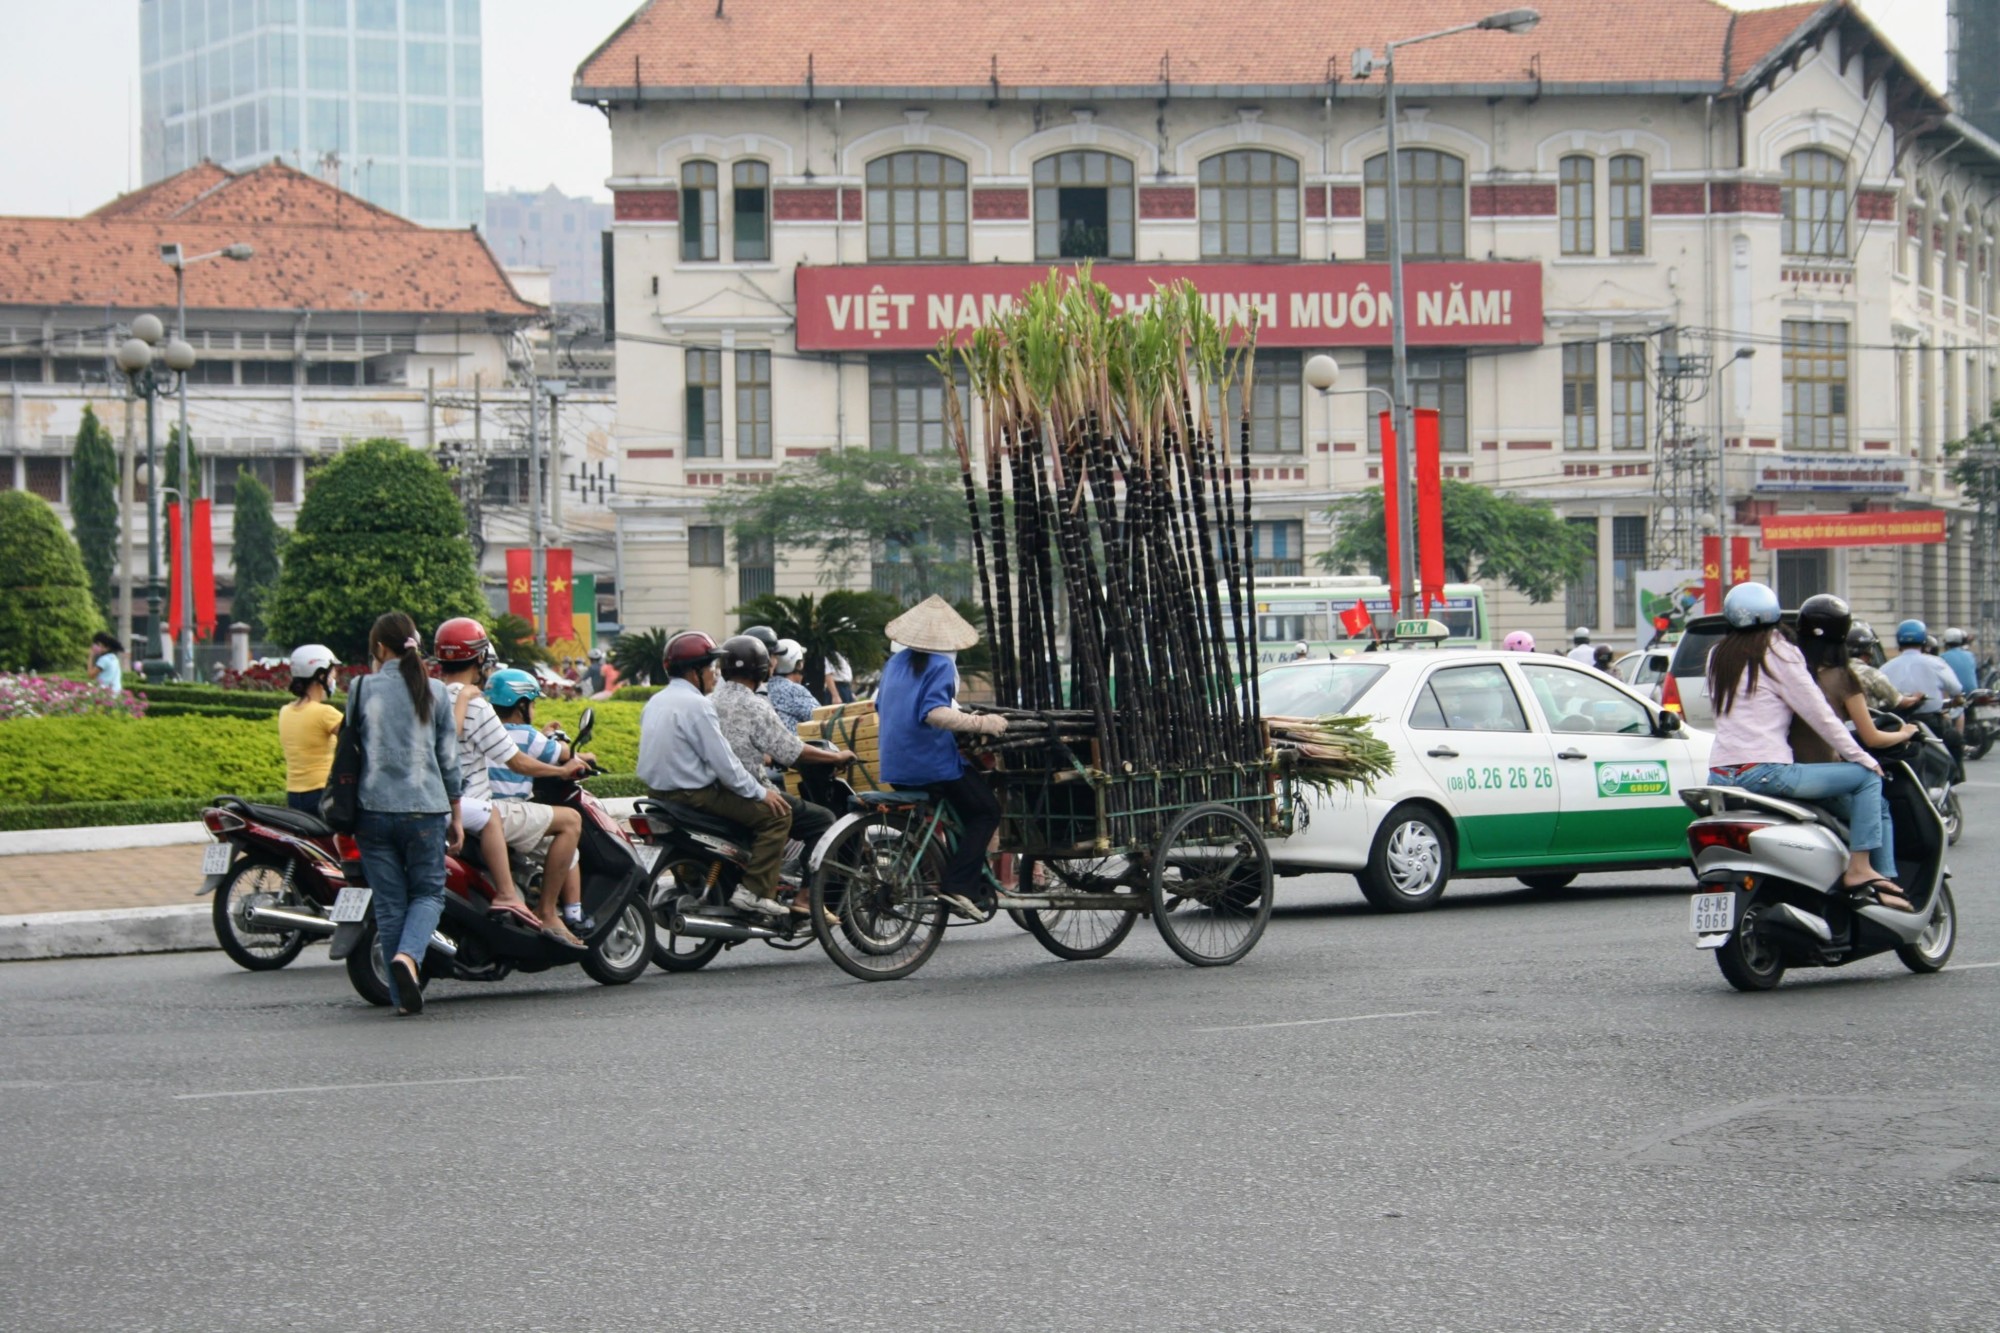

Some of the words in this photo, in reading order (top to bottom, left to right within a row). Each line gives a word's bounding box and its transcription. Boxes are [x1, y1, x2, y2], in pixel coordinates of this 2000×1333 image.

[826, 284, 915, 338] VIỆT
[928, 294, 1013, 330] NAM
[1290, 282, 1398, 328] MUÔN
[1417, 281, 1512, 326] NĂM!
[1508, 766, 1527, 789] 26
[1533, 766, 1553, 789] 26
[1630, 783, 1662, 793] GROUP
[1697, 896, 1729, 913] 49-N3
[1695, 912, 1728, 930] 5068
